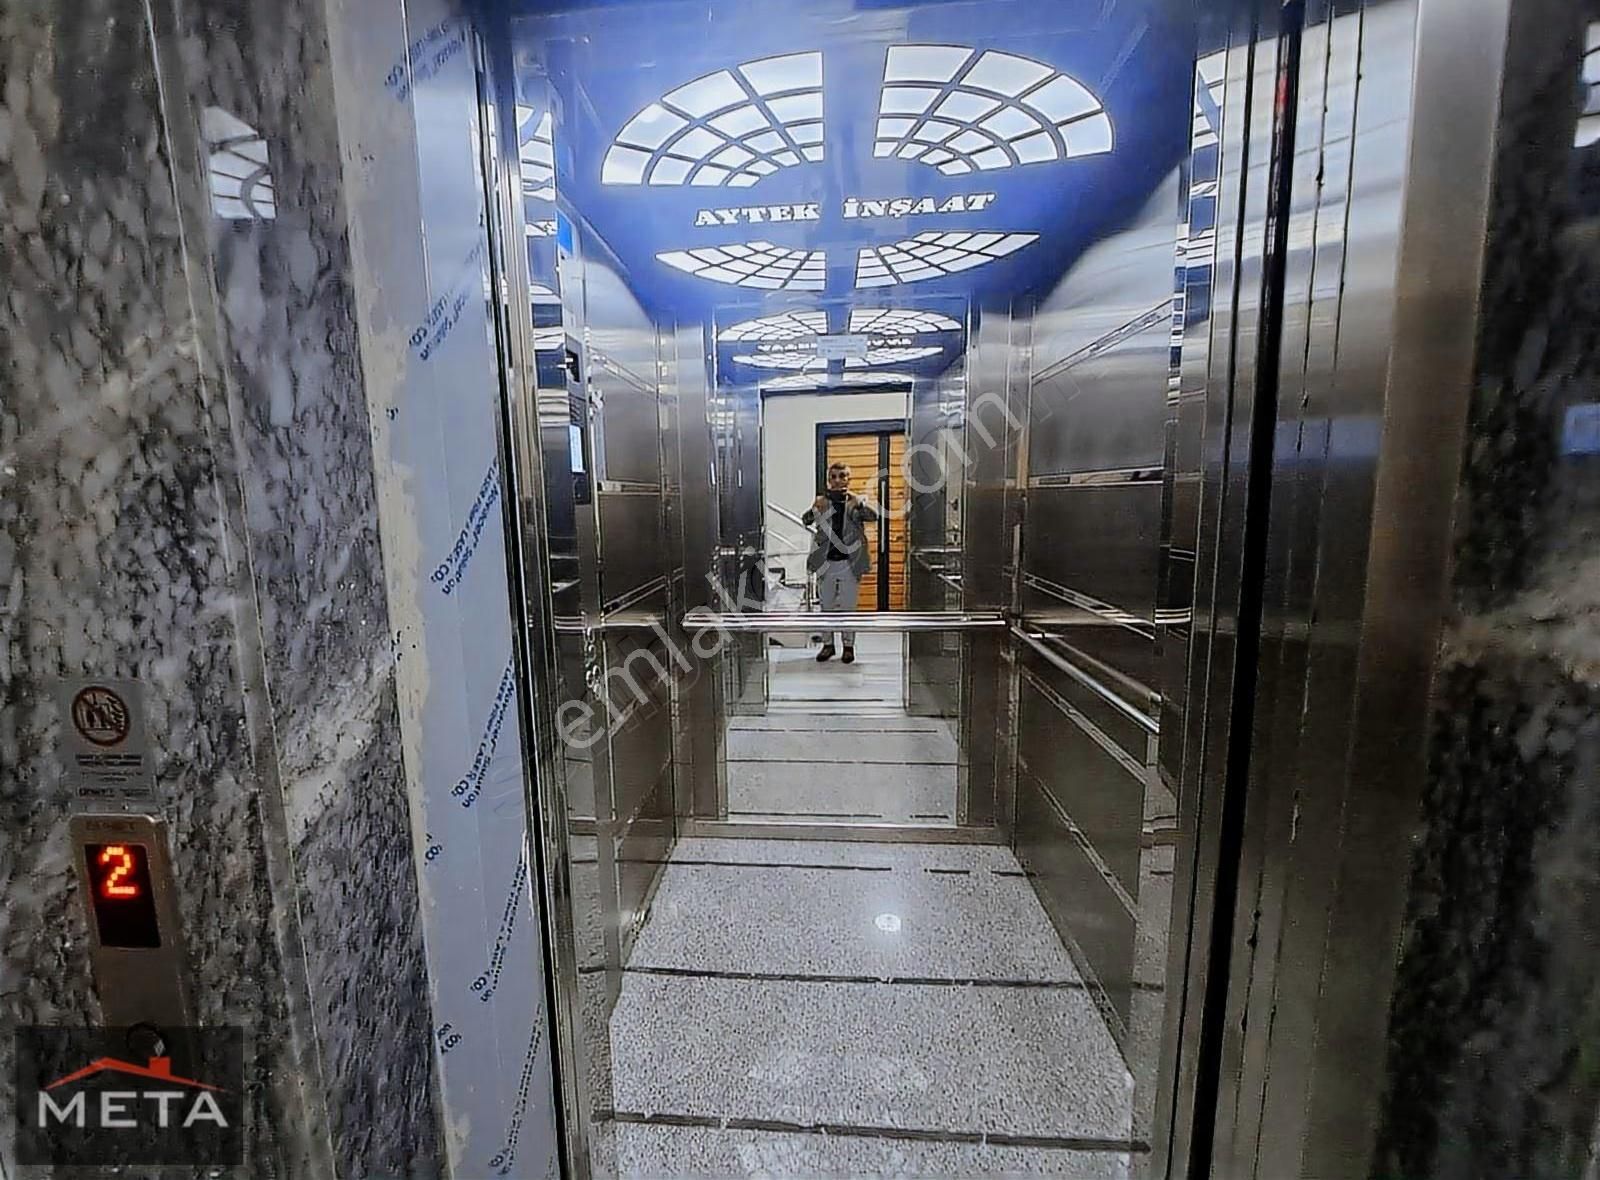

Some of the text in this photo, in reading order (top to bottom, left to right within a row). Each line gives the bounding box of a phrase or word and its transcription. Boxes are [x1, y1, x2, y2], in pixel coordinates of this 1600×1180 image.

[693, 192, 997, 227] AYTEK İNŞAAT
[101, 846, 136, 894] 2
